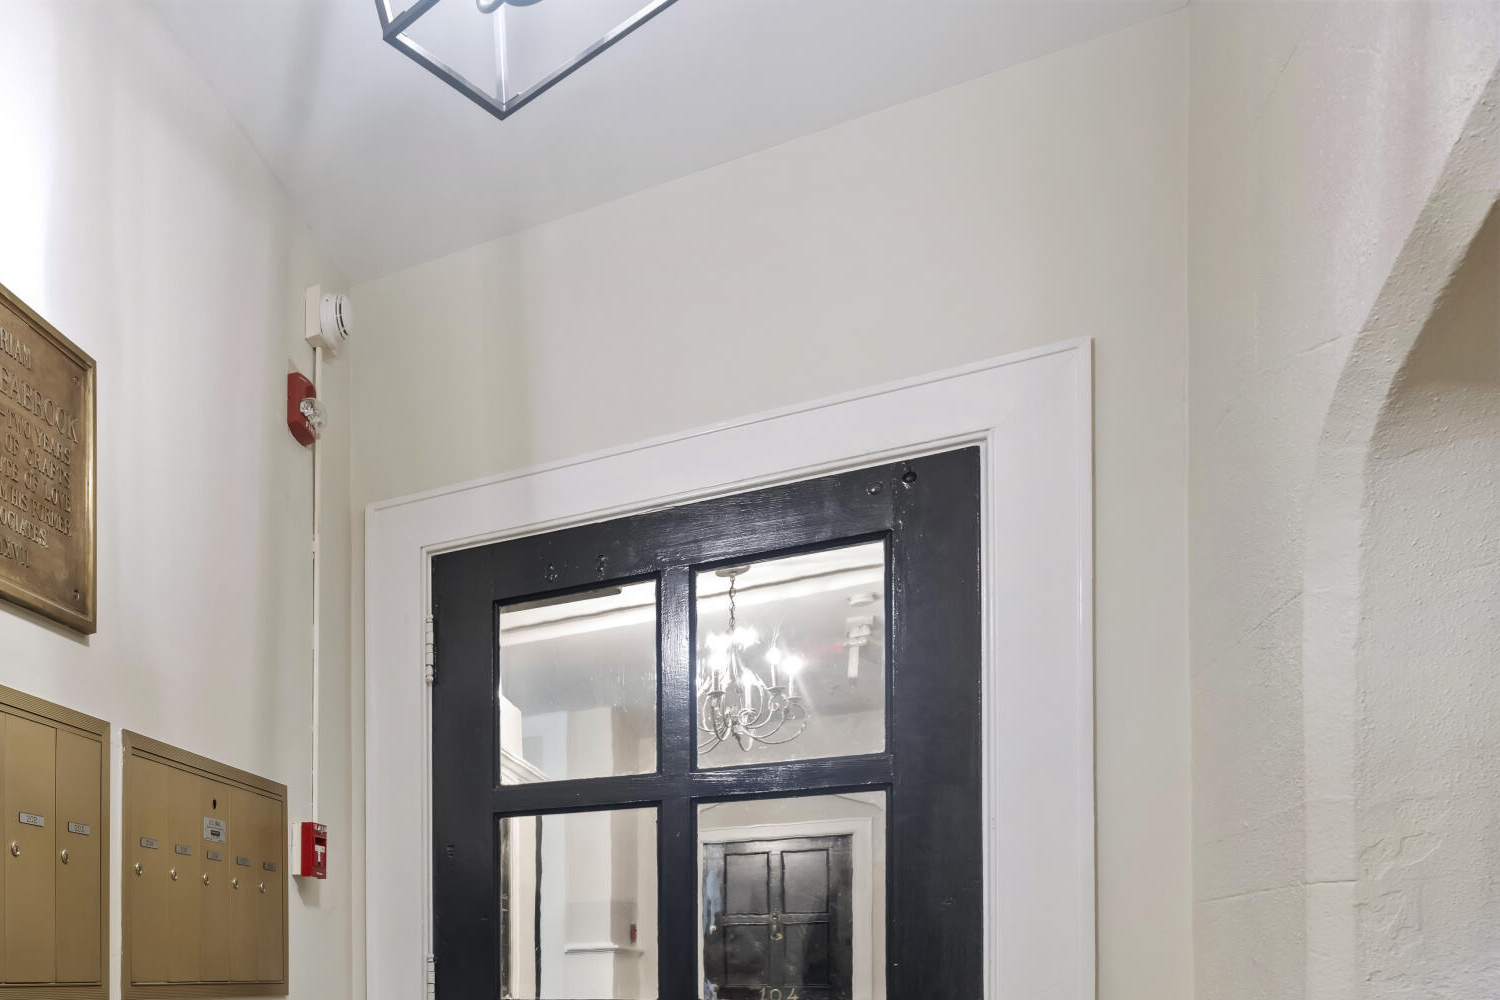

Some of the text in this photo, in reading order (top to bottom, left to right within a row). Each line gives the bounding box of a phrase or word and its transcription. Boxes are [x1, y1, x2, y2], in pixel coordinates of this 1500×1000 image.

[5, 433, 19, 456] OF
[26, 448, 71, 490] CRAFTS
[35, 427, 71, 467] YEARS
[11, 486, 28, 513] HIS
[31, 498, 72, 538] FORMER
[24, 470, 38, 494] OF
[44, 480, 71, 513] LOVE
[759, 986, 800, 1000] 104
